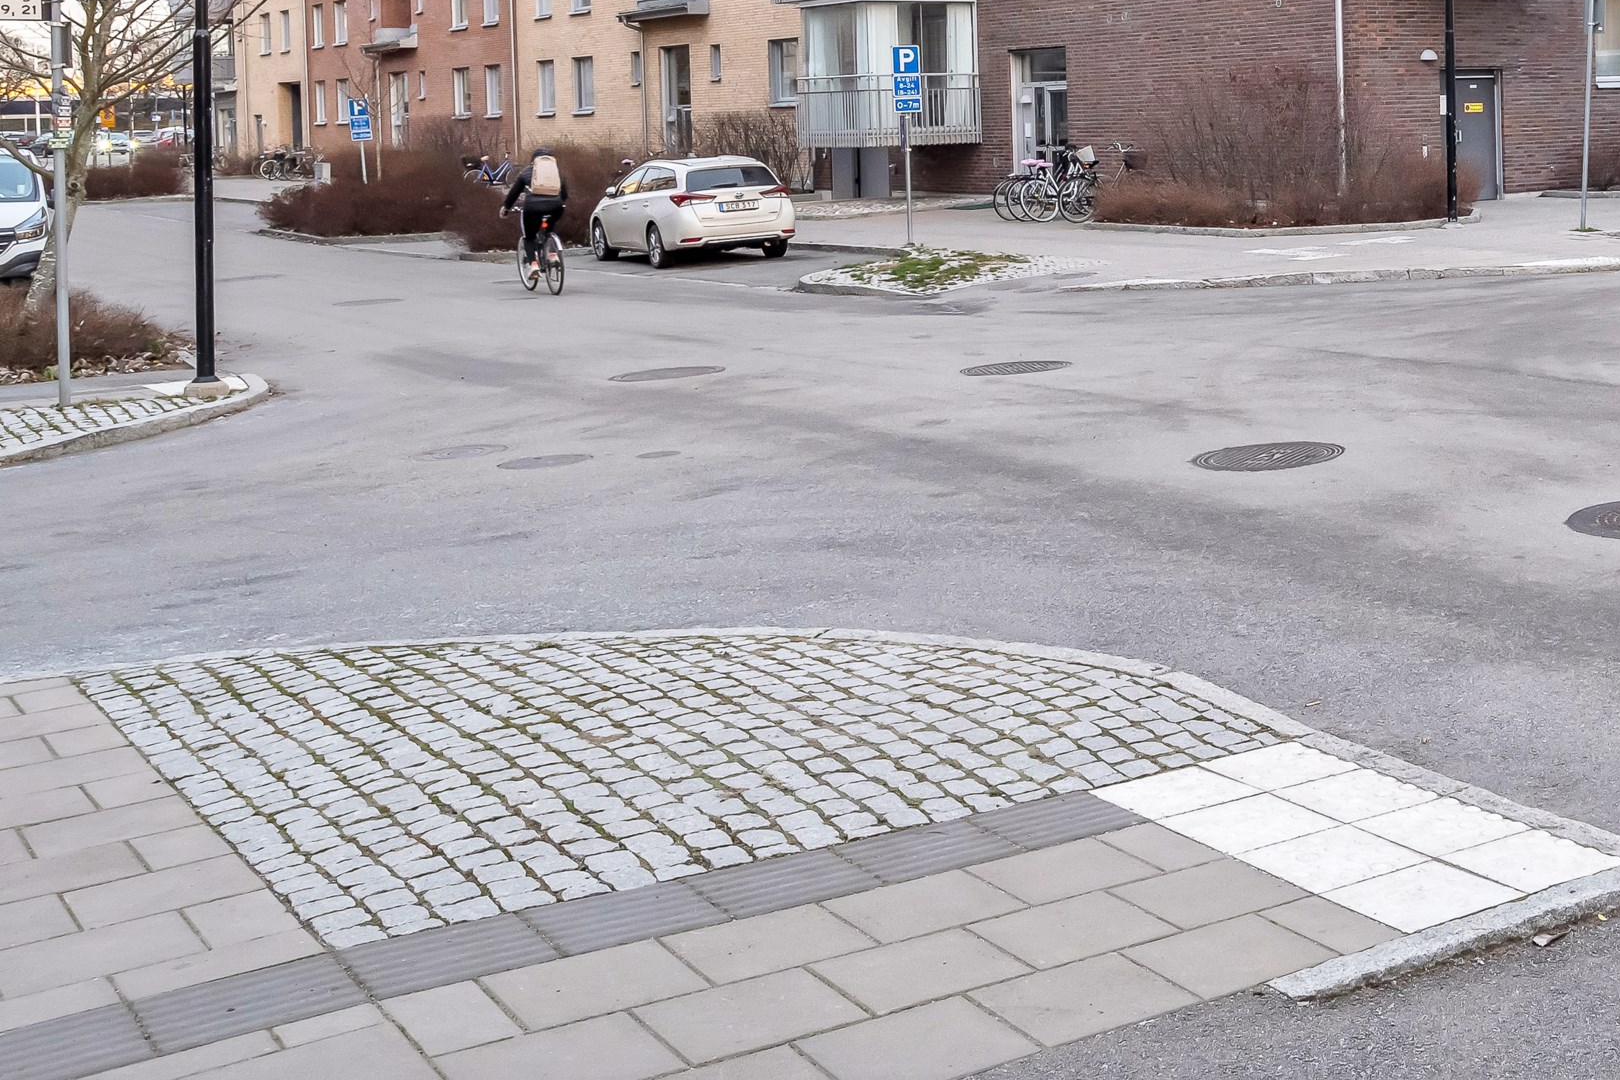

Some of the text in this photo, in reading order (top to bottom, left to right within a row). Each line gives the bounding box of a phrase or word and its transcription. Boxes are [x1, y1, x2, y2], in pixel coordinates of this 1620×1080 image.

[21, 5, 36, 15] 21
[899, 48, 914, 72] P
[353, 100, 365, 115] P
[897, 101, 919, 109] 0-7m
